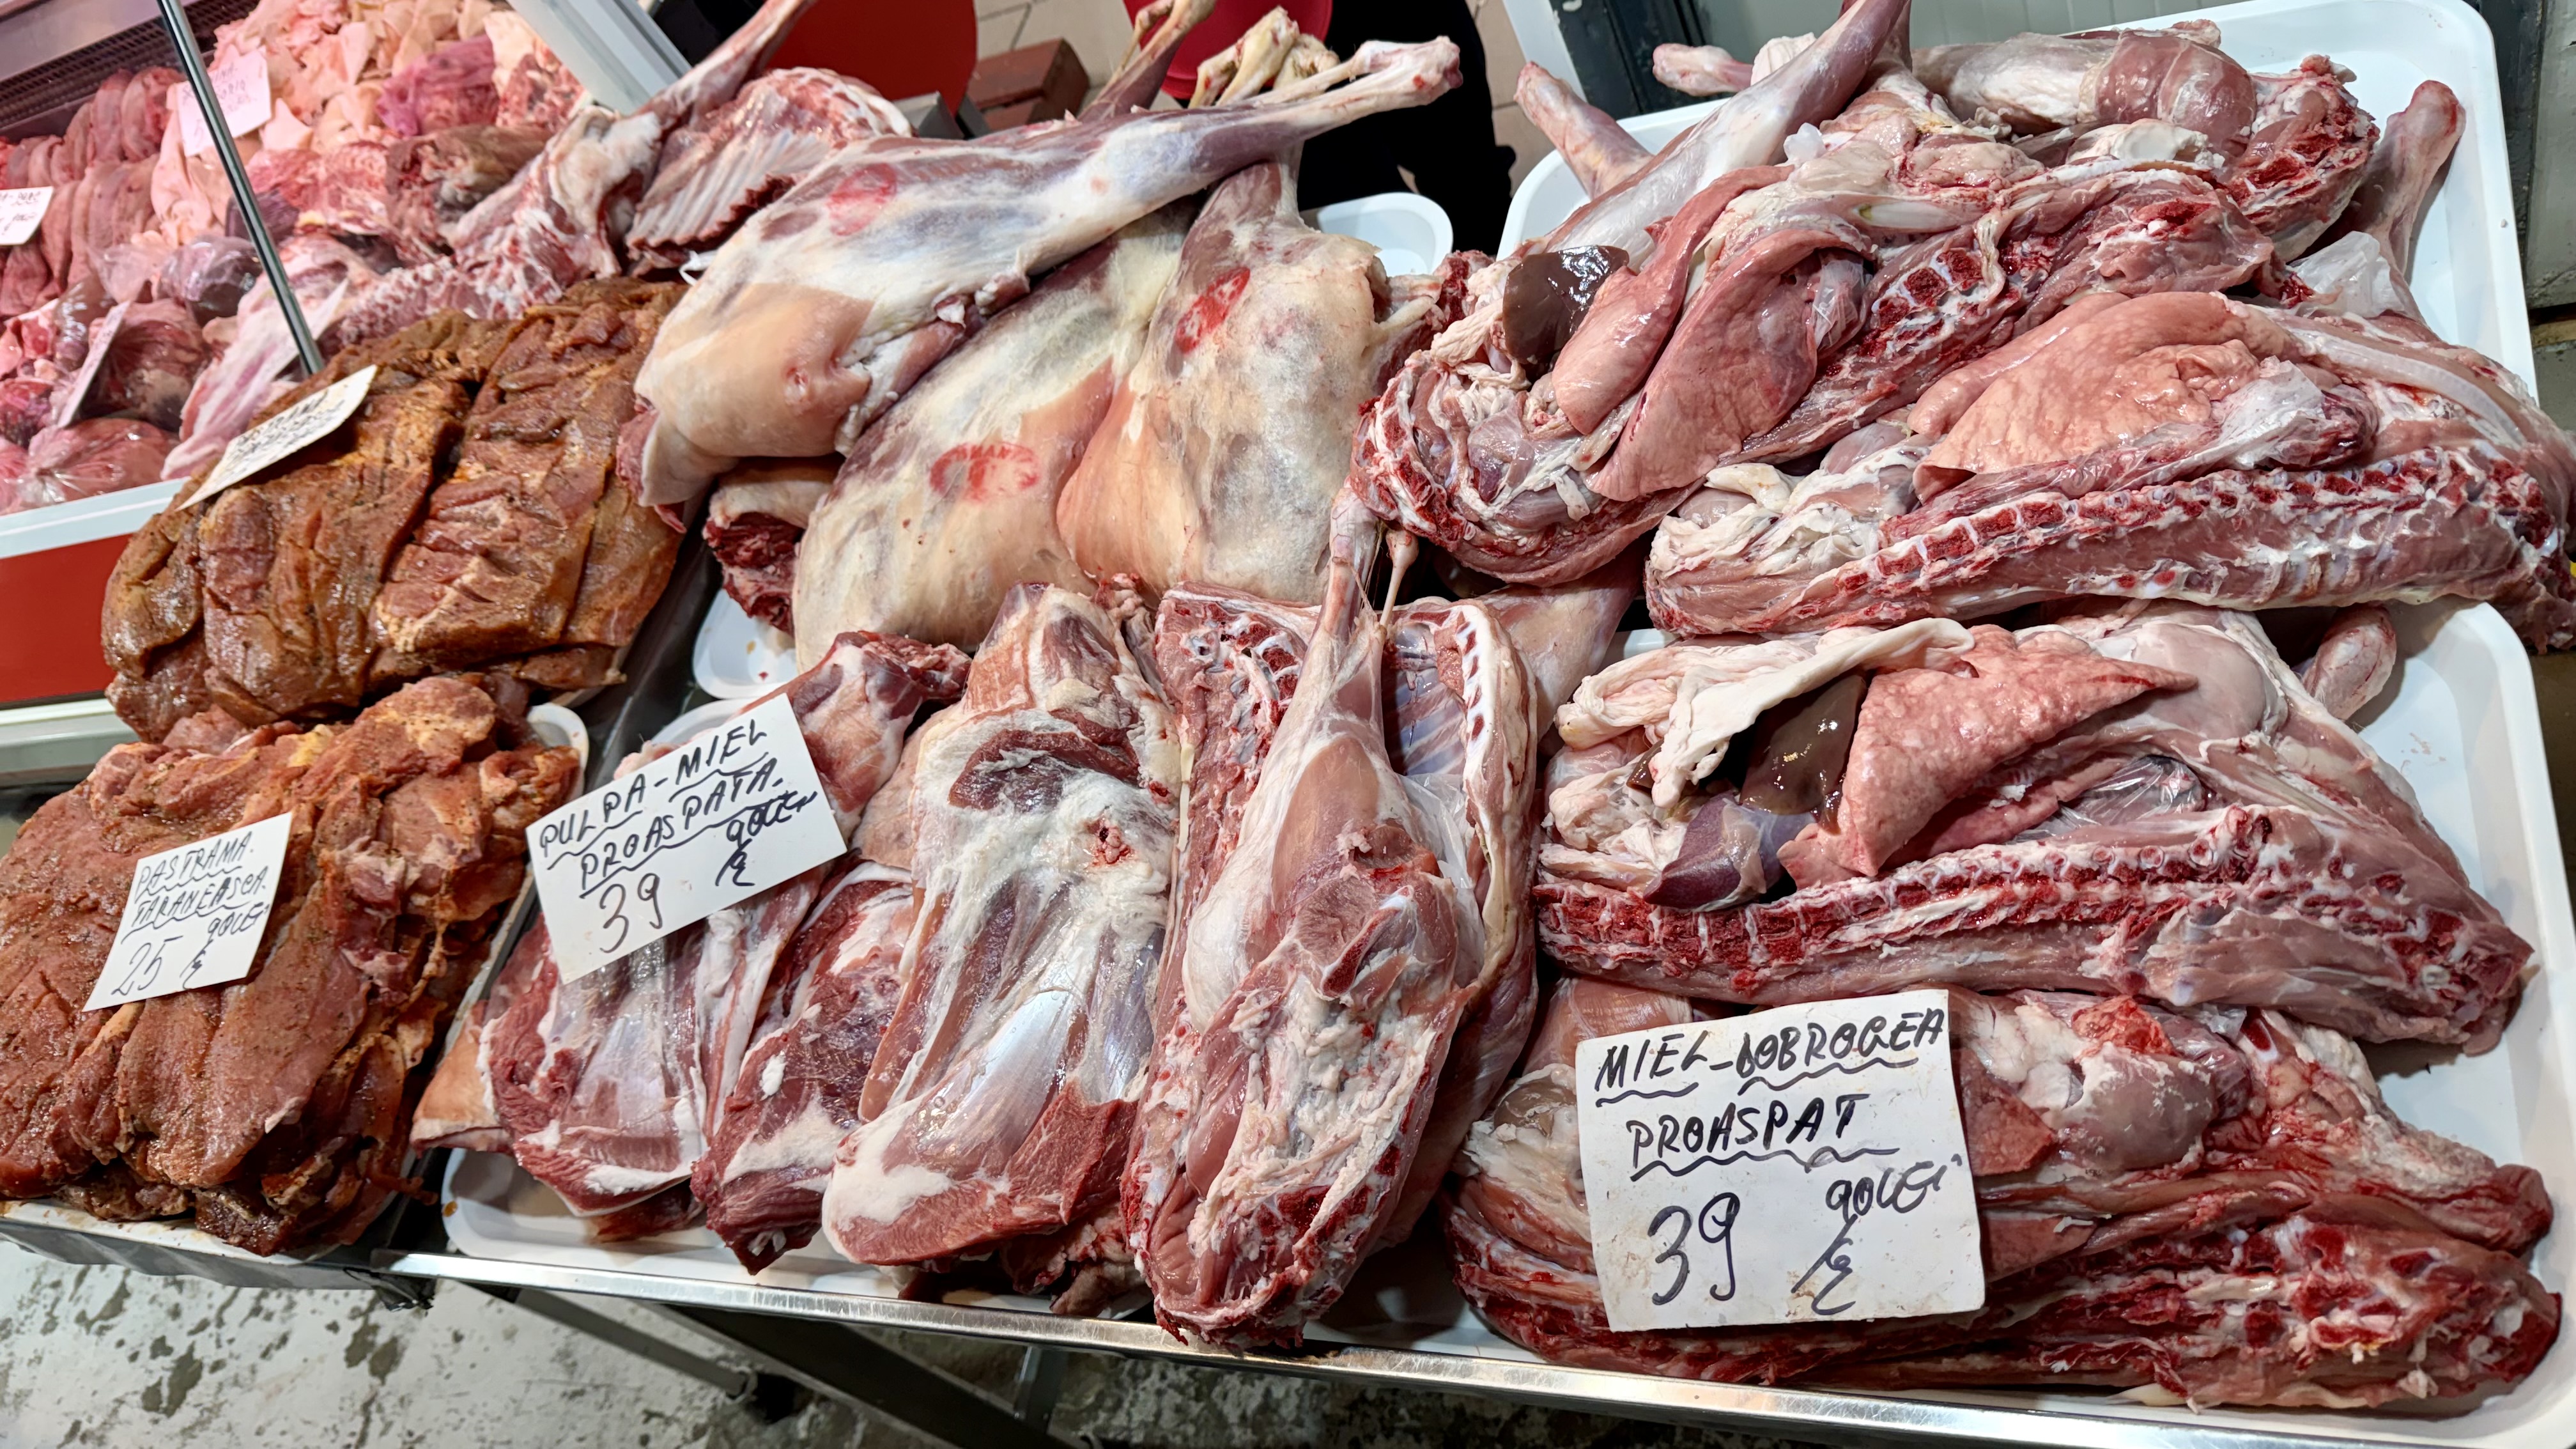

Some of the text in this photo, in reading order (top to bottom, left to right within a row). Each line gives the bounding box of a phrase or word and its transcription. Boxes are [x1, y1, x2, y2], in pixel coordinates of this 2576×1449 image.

[599, 872, 663, 954] 39
[111, 935, 184, 996] 25
[1625, 1093, 1870, 1170] PROASPAT
[1647, 1192, 1741, 1306] 39
